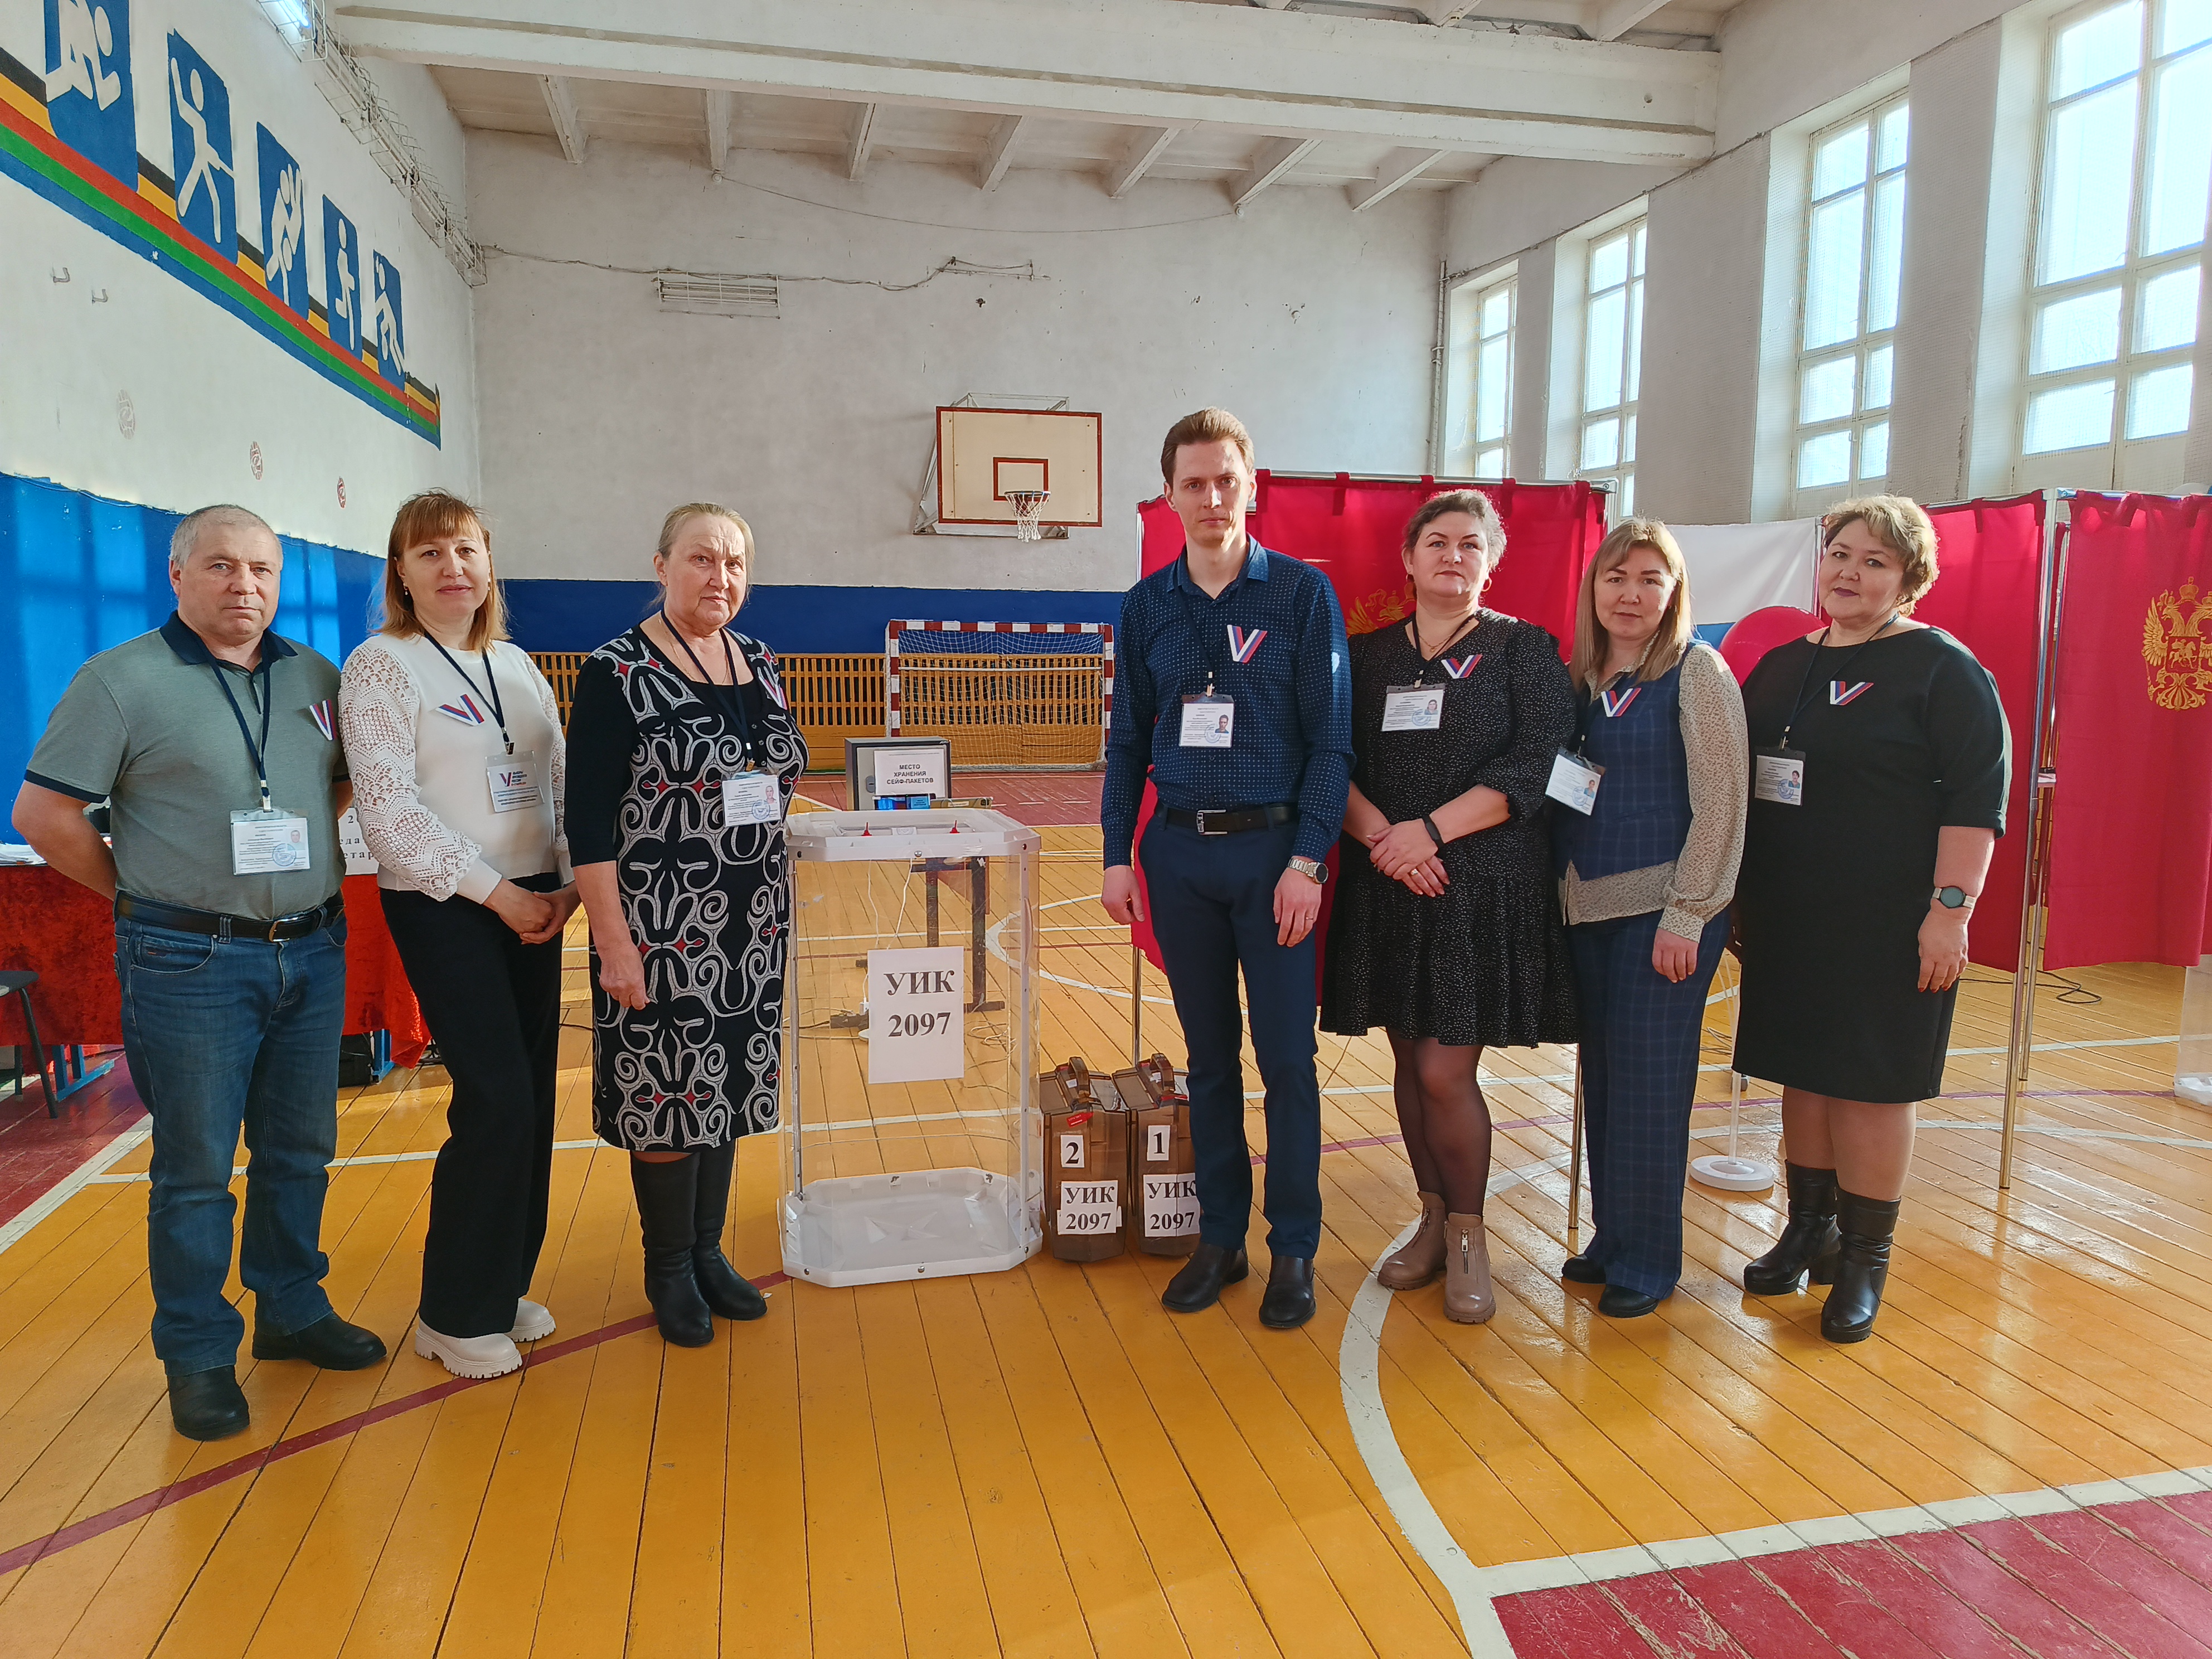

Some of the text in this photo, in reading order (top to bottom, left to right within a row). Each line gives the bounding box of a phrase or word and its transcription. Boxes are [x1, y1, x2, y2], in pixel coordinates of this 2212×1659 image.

[348, 815, 354, 824] 2
[883, 970, 955, 996] УИК
[888, 1012, 951, 1037] 2097
[1153, 1132, 1165, 1154] 1
[1065, 1142, 1080, 1165] 2
[1064, 1186, 1115, 1204] УИК
[1146, 1180, 1196, 1199] УИК
[1065, 1212, 1112, 1230] 2097
[1150, 1211, 1195, 1230] 2097
